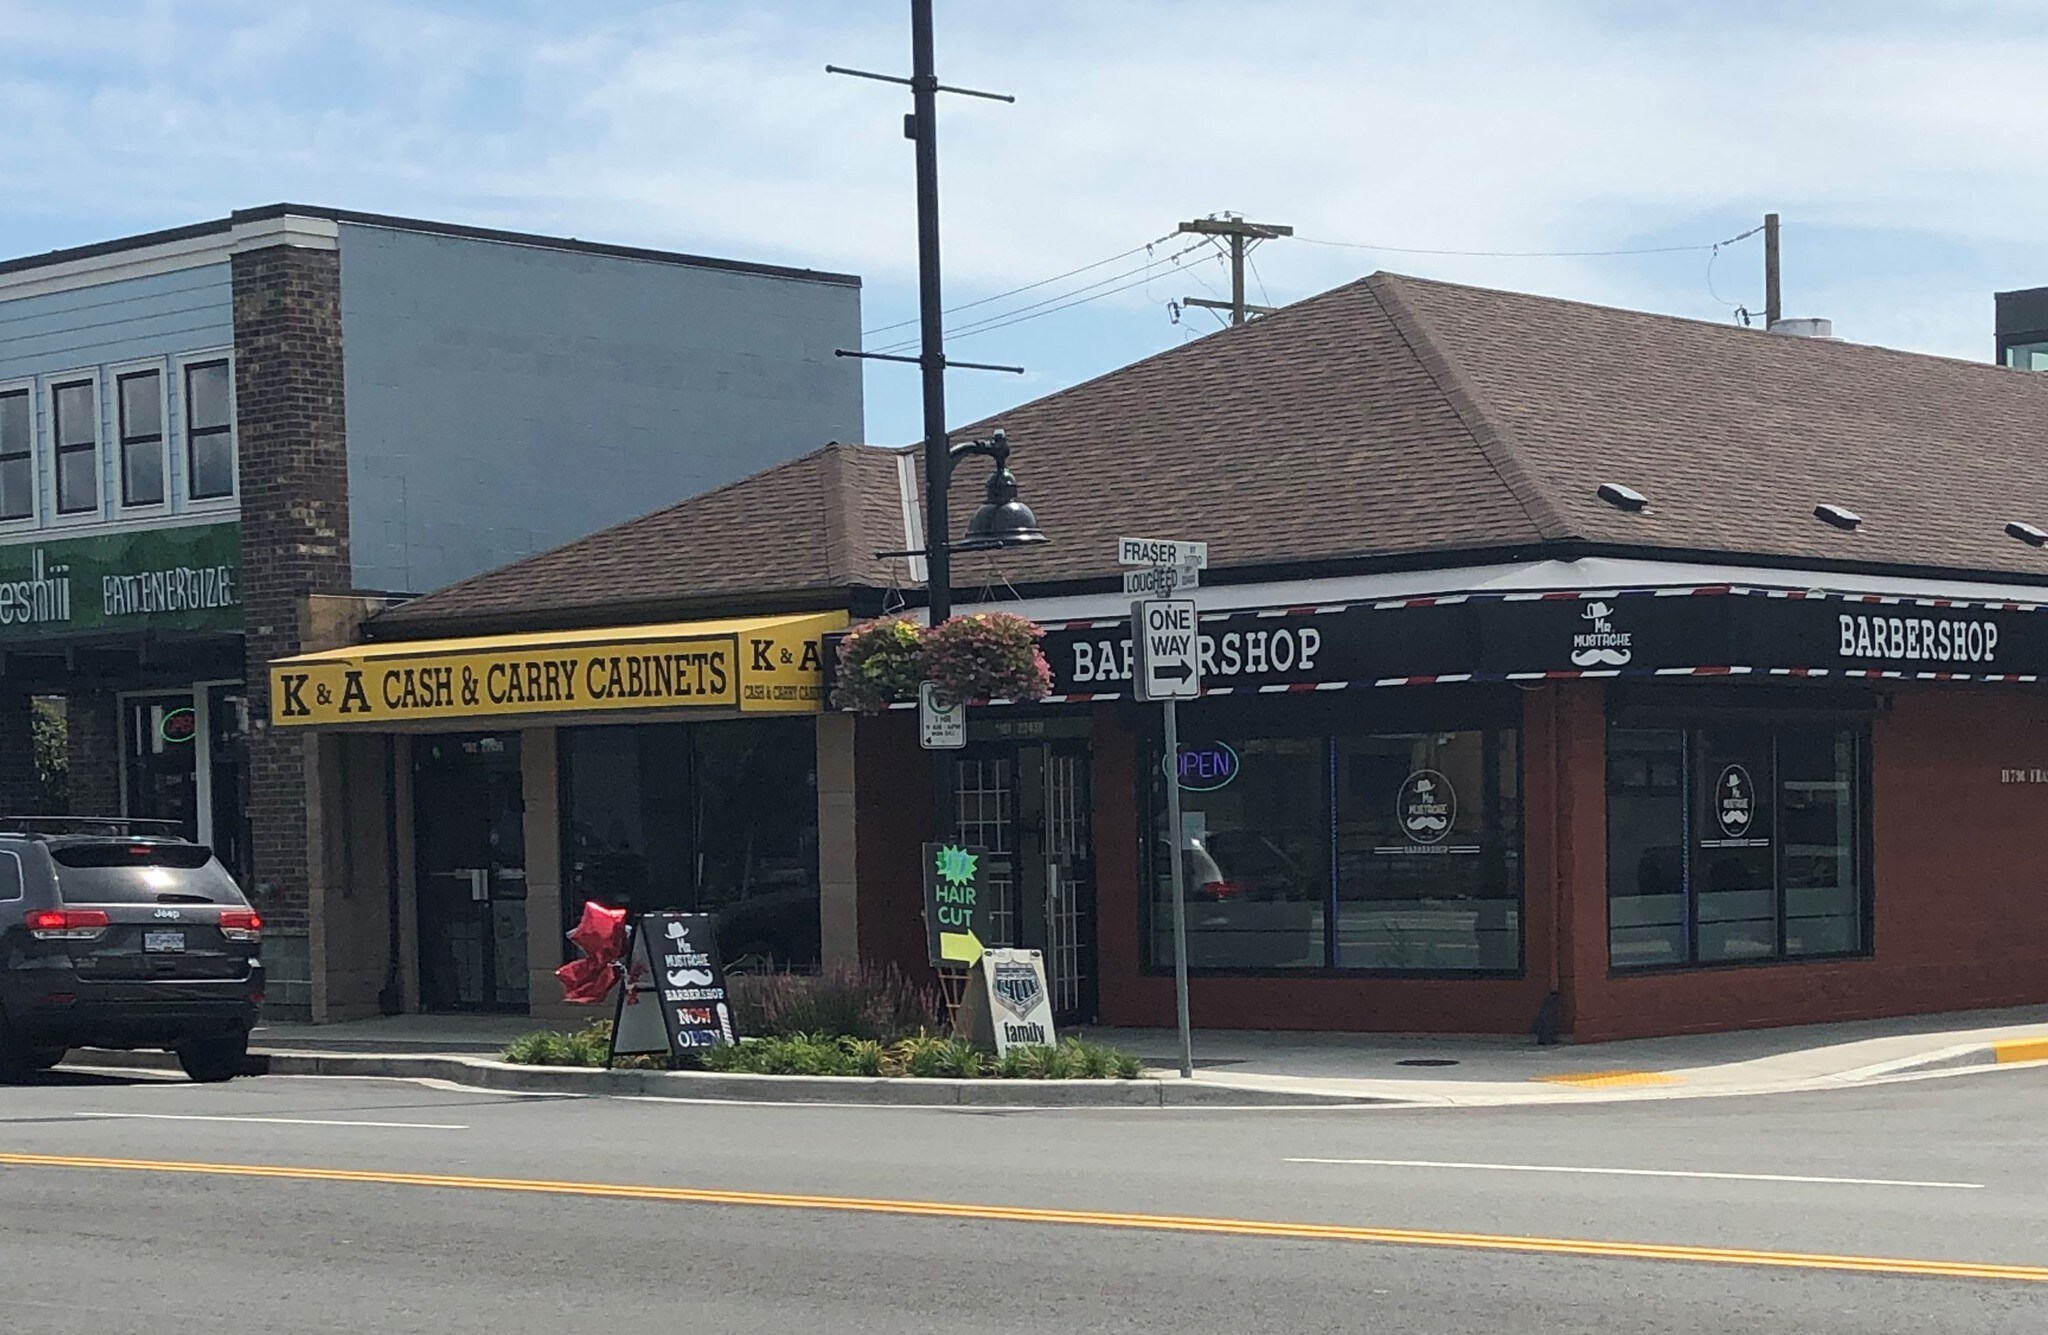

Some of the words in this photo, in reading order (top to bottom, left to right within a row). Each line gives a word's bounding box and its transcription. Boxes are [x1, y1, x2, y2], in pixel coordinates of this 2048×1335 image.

[1124, 542, 1177, 563] FRASER
[1126, 568, 1178, 593] LOUGHEED
[1149, 609, 1191, 631] ONE
[1151, 635, 1191, 657] WAY
[1573, 633, 1632, 647] MUSTACHE
[1838, 615, 1998, 662] BARBERSHOP
[751, 639, 776, 671] K
[779, 648, 793, 664] &
[797, 640, 822, 671] A
[280, 675, 311, 716] K
[316, 684, 333, 706] &
[338, 671, 371, 713] A
[383, 667, 453, 710] CASH
[461, 665, 479, 705] &
[487, 660, 578, 705] CARRY
[586, 651, 727, 699] CABINETS
[935, 884, 976, 905] HAIR
[153, 909, 180, 919] Jeep
[938, 905, 973, 928] CUT
[664, 988, 724, 1001] BARBERSHOP
[676, 1008, 712, 1025] NOW
[677, 1029, 722, 1047] OPEN
[1004, 1021, 1045, 1045] family
